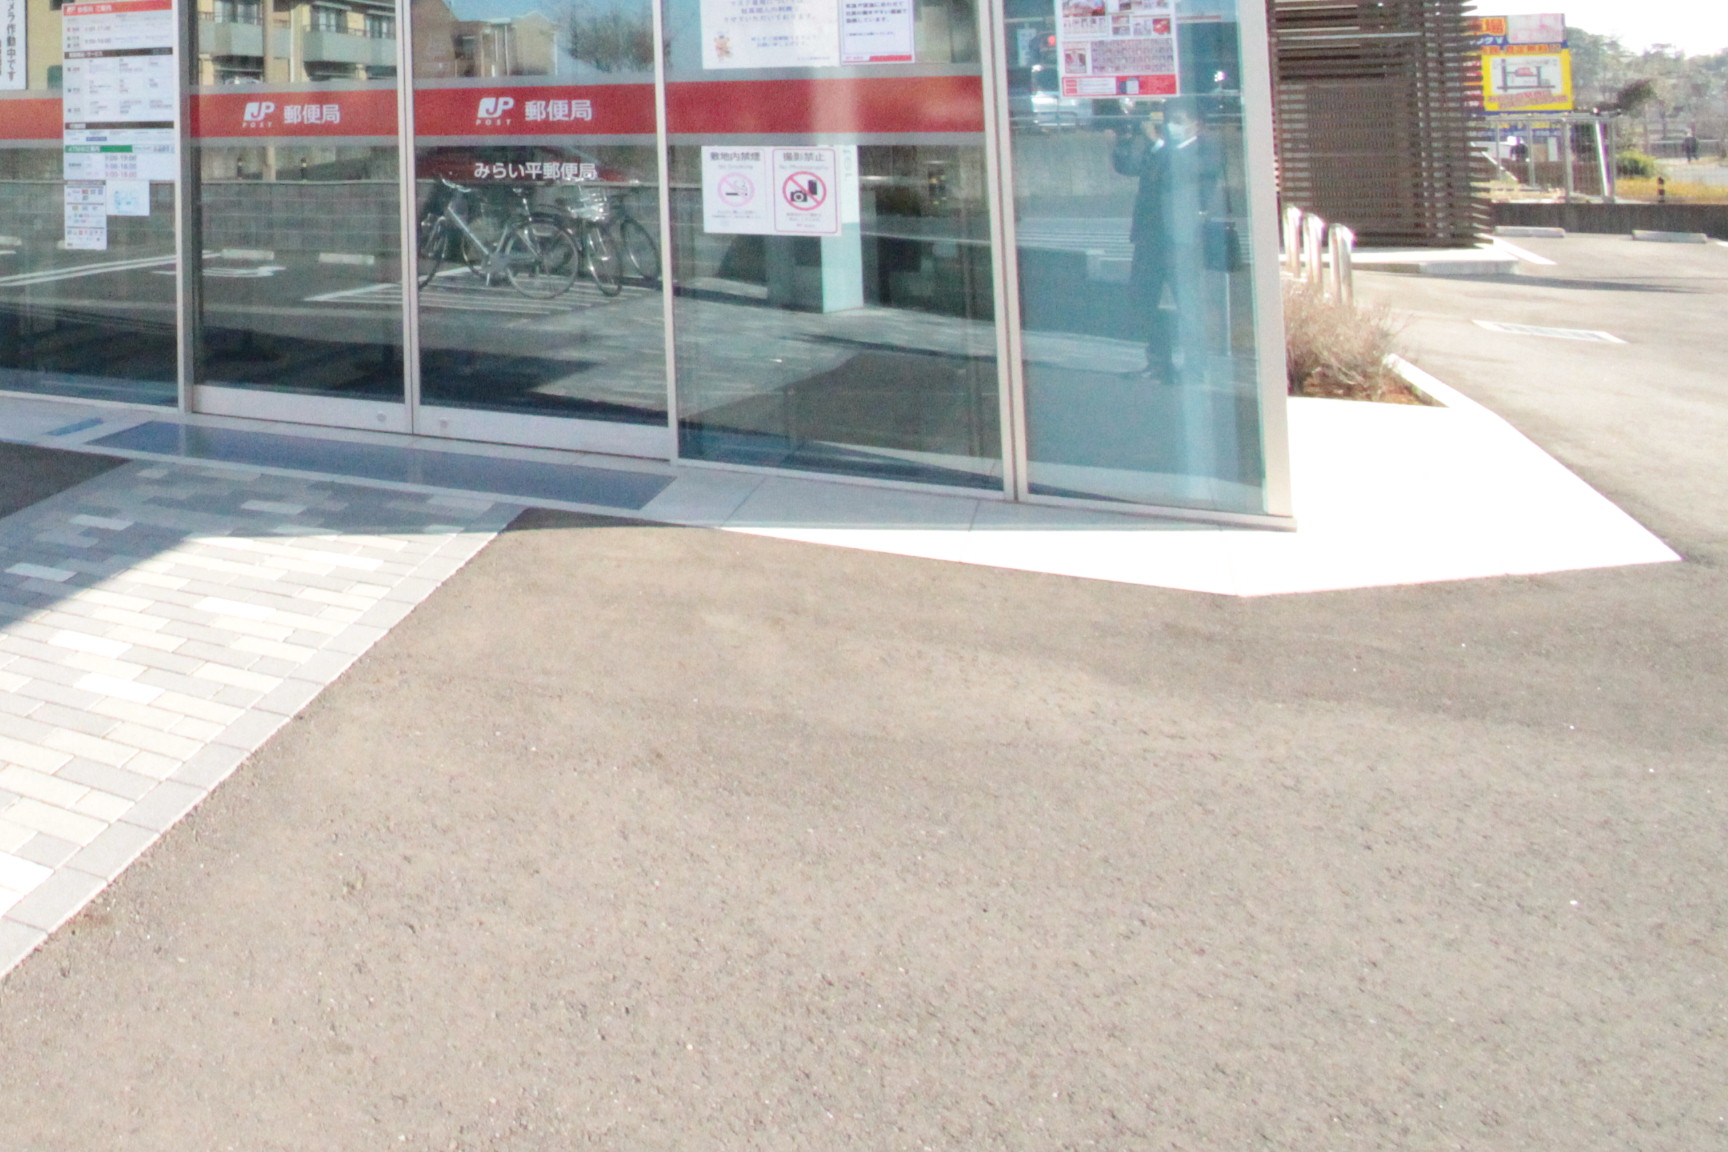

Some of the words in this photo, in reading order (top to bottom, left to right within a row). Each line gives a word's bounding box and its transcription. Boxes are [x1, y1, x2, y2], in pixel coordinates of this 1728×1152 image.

[283, 103, 341, 124] 郵便局
[524, 99, 592, 121] 郵便局
[710, 152, 760, 162] 敷地内禁煙
[783, 151, 826, 162] 撮影禁止
[474, 162, 597, 181] みらい平郵便局
